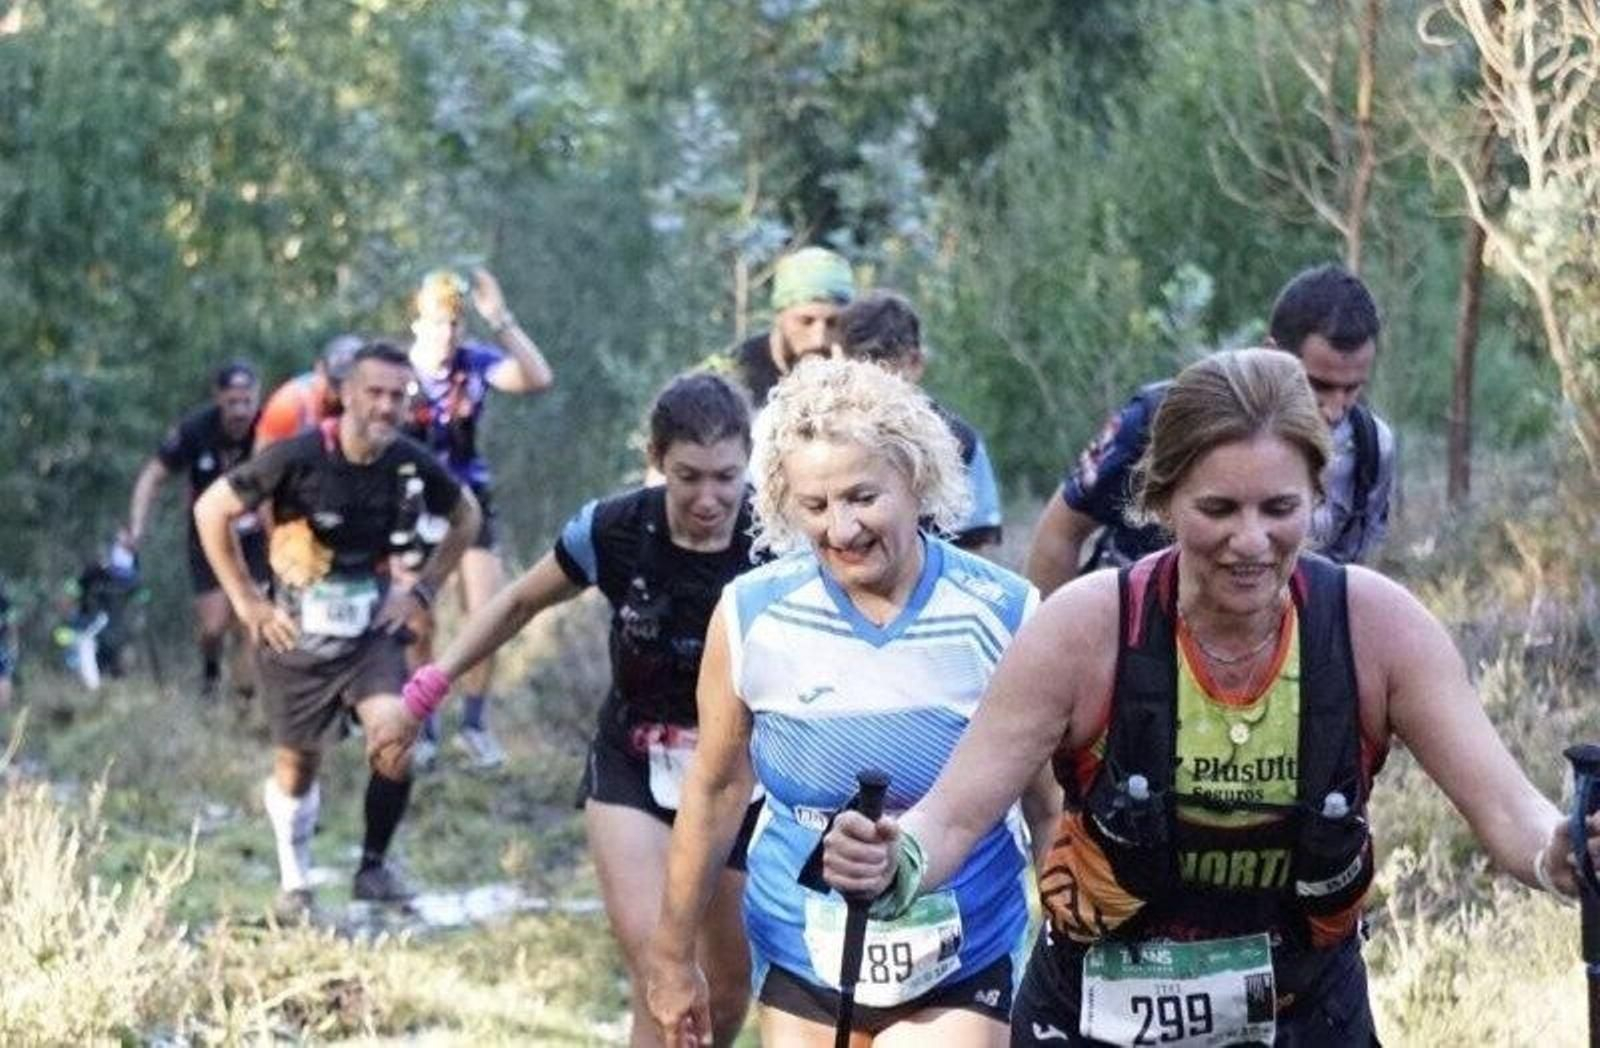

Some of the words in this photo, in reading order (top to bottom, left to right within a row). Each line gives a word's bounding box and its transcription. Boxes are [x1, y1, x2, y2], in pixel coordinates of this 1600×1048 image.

[1193, 787, 1264, 801] Seguros
[857, 942, 914, 984] 89
[1131, 992, 1213, 1046] 299
